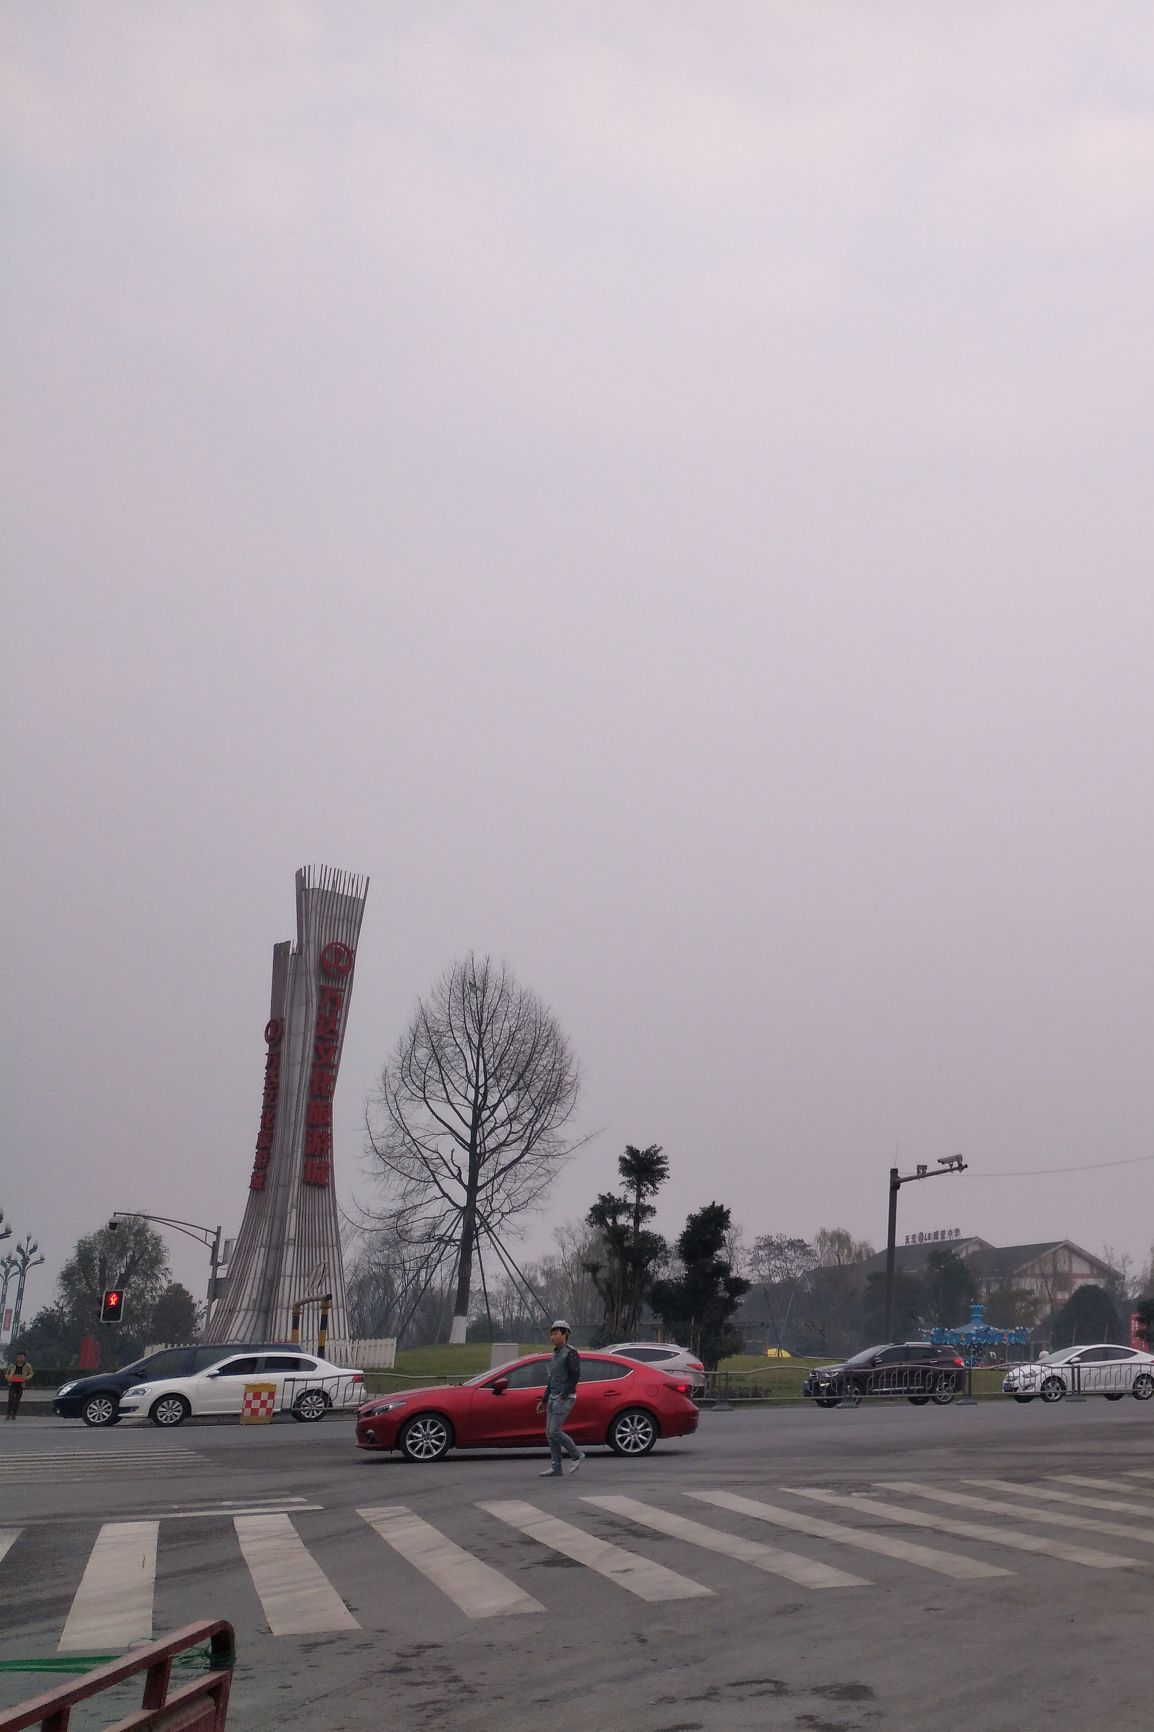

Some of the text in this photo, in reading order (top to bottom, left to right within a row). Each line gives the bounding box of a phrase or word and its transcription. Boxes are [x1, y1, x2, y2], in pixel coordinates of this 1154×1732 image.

[303, 984, 344, 1187] 万达文化旅游城
